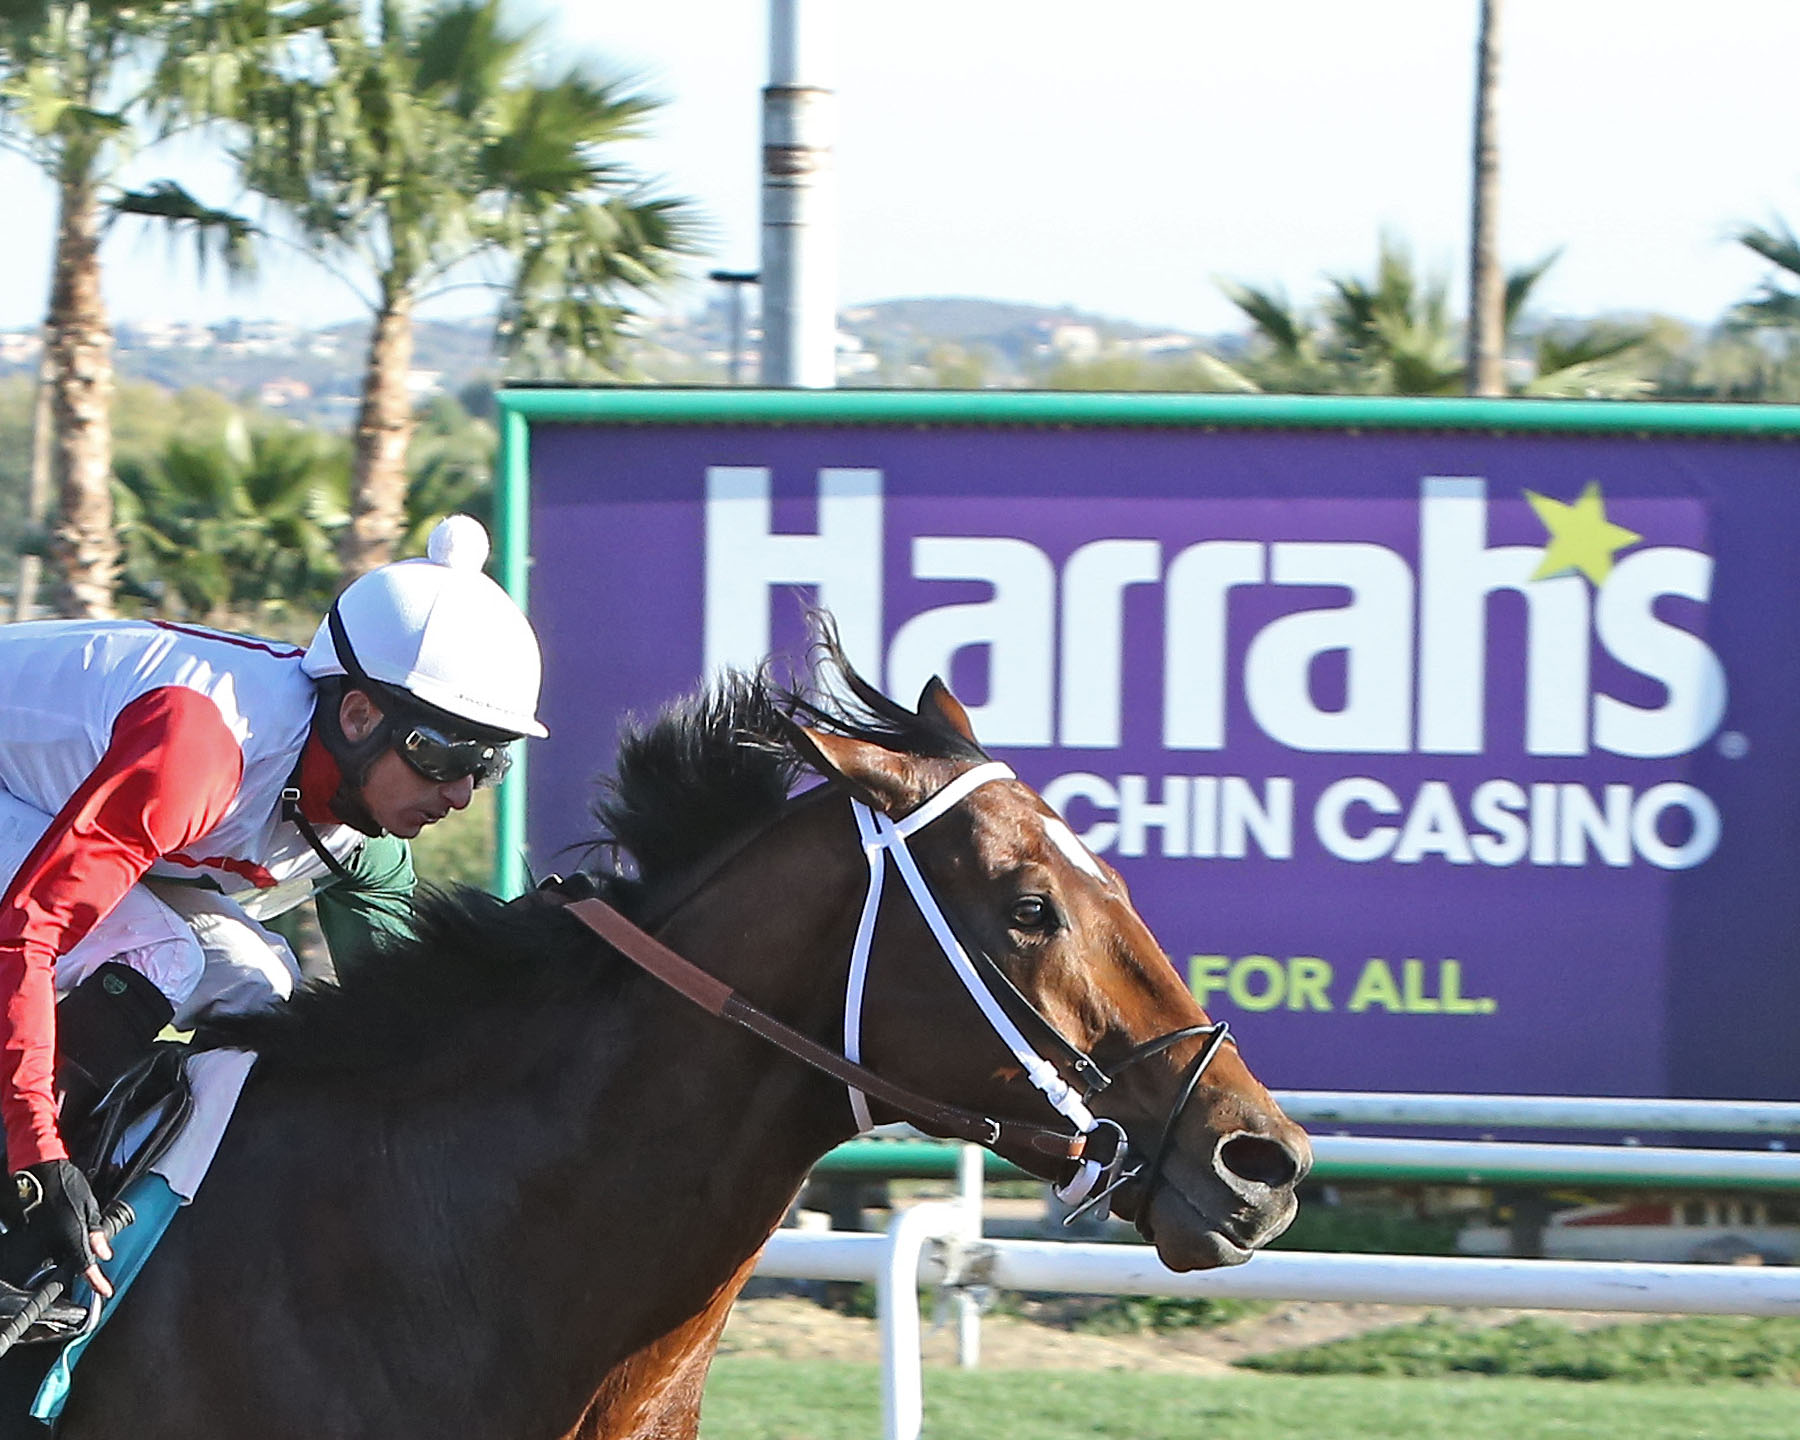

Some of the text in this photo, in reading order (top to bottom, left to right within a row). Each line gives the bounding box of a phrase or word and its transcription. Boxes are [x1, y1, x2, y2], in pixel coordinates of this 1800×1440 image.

[1314, 777, 1721, 870] CASINO
[1188, 955, 1496, 1014] FOR ALL.
